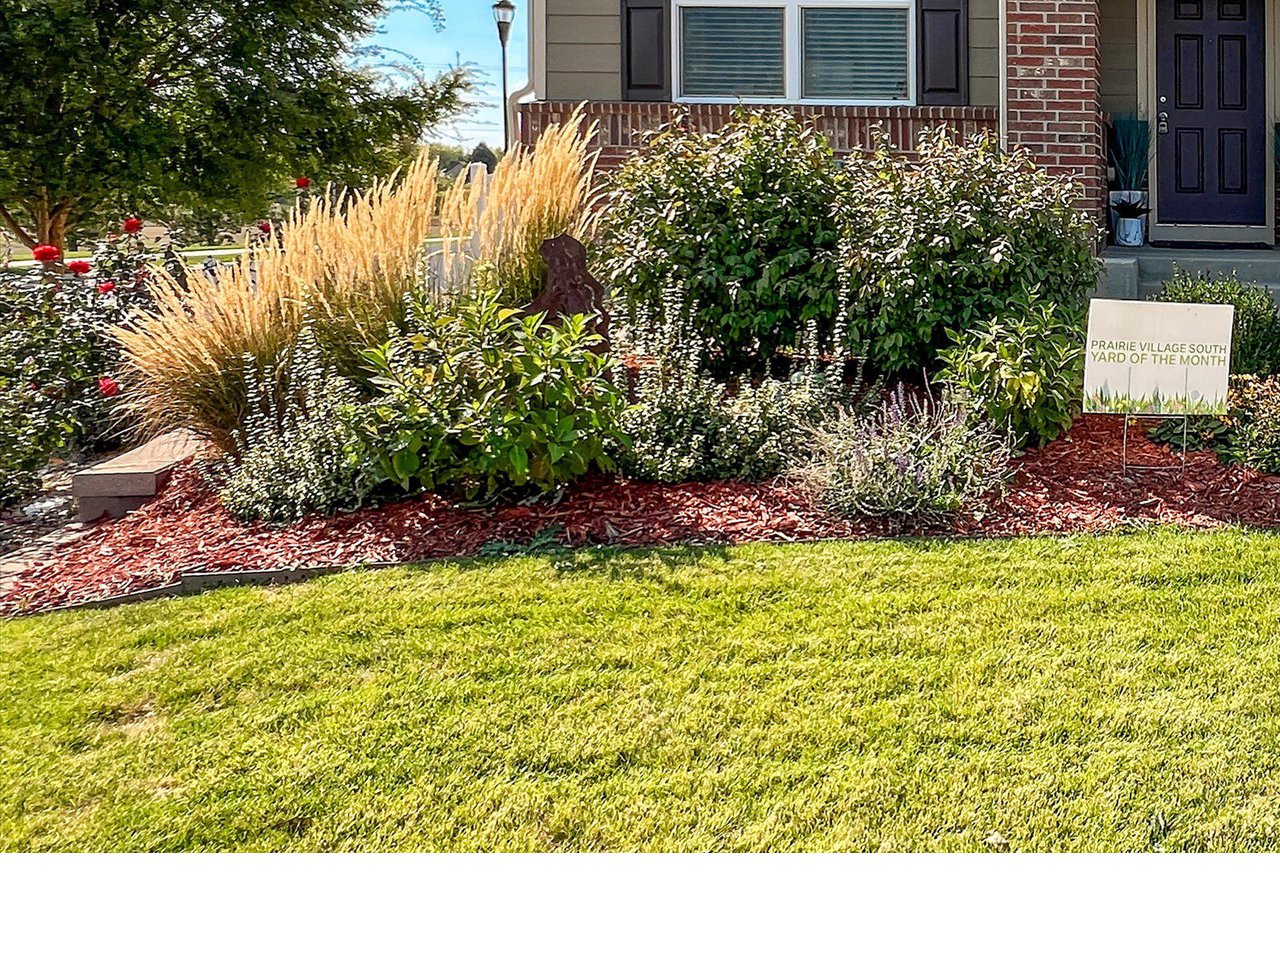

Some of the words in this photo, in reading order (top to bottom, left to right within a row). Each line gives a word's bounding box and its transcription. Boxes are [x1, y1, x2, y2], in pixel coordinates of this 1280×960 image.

[1091, 340, 1136, 351] PRAIRIE
[1139, 342, 1186, 353] VILLAGE
[1188, 343, 1227, 354] SOUTH
[1091, 351, 1126, 363] YARD
[1129, 353, 1147, 364] OF
[1151, 354, 1176, 365] THE
[1179, 355, 1226, 366] MONTH
